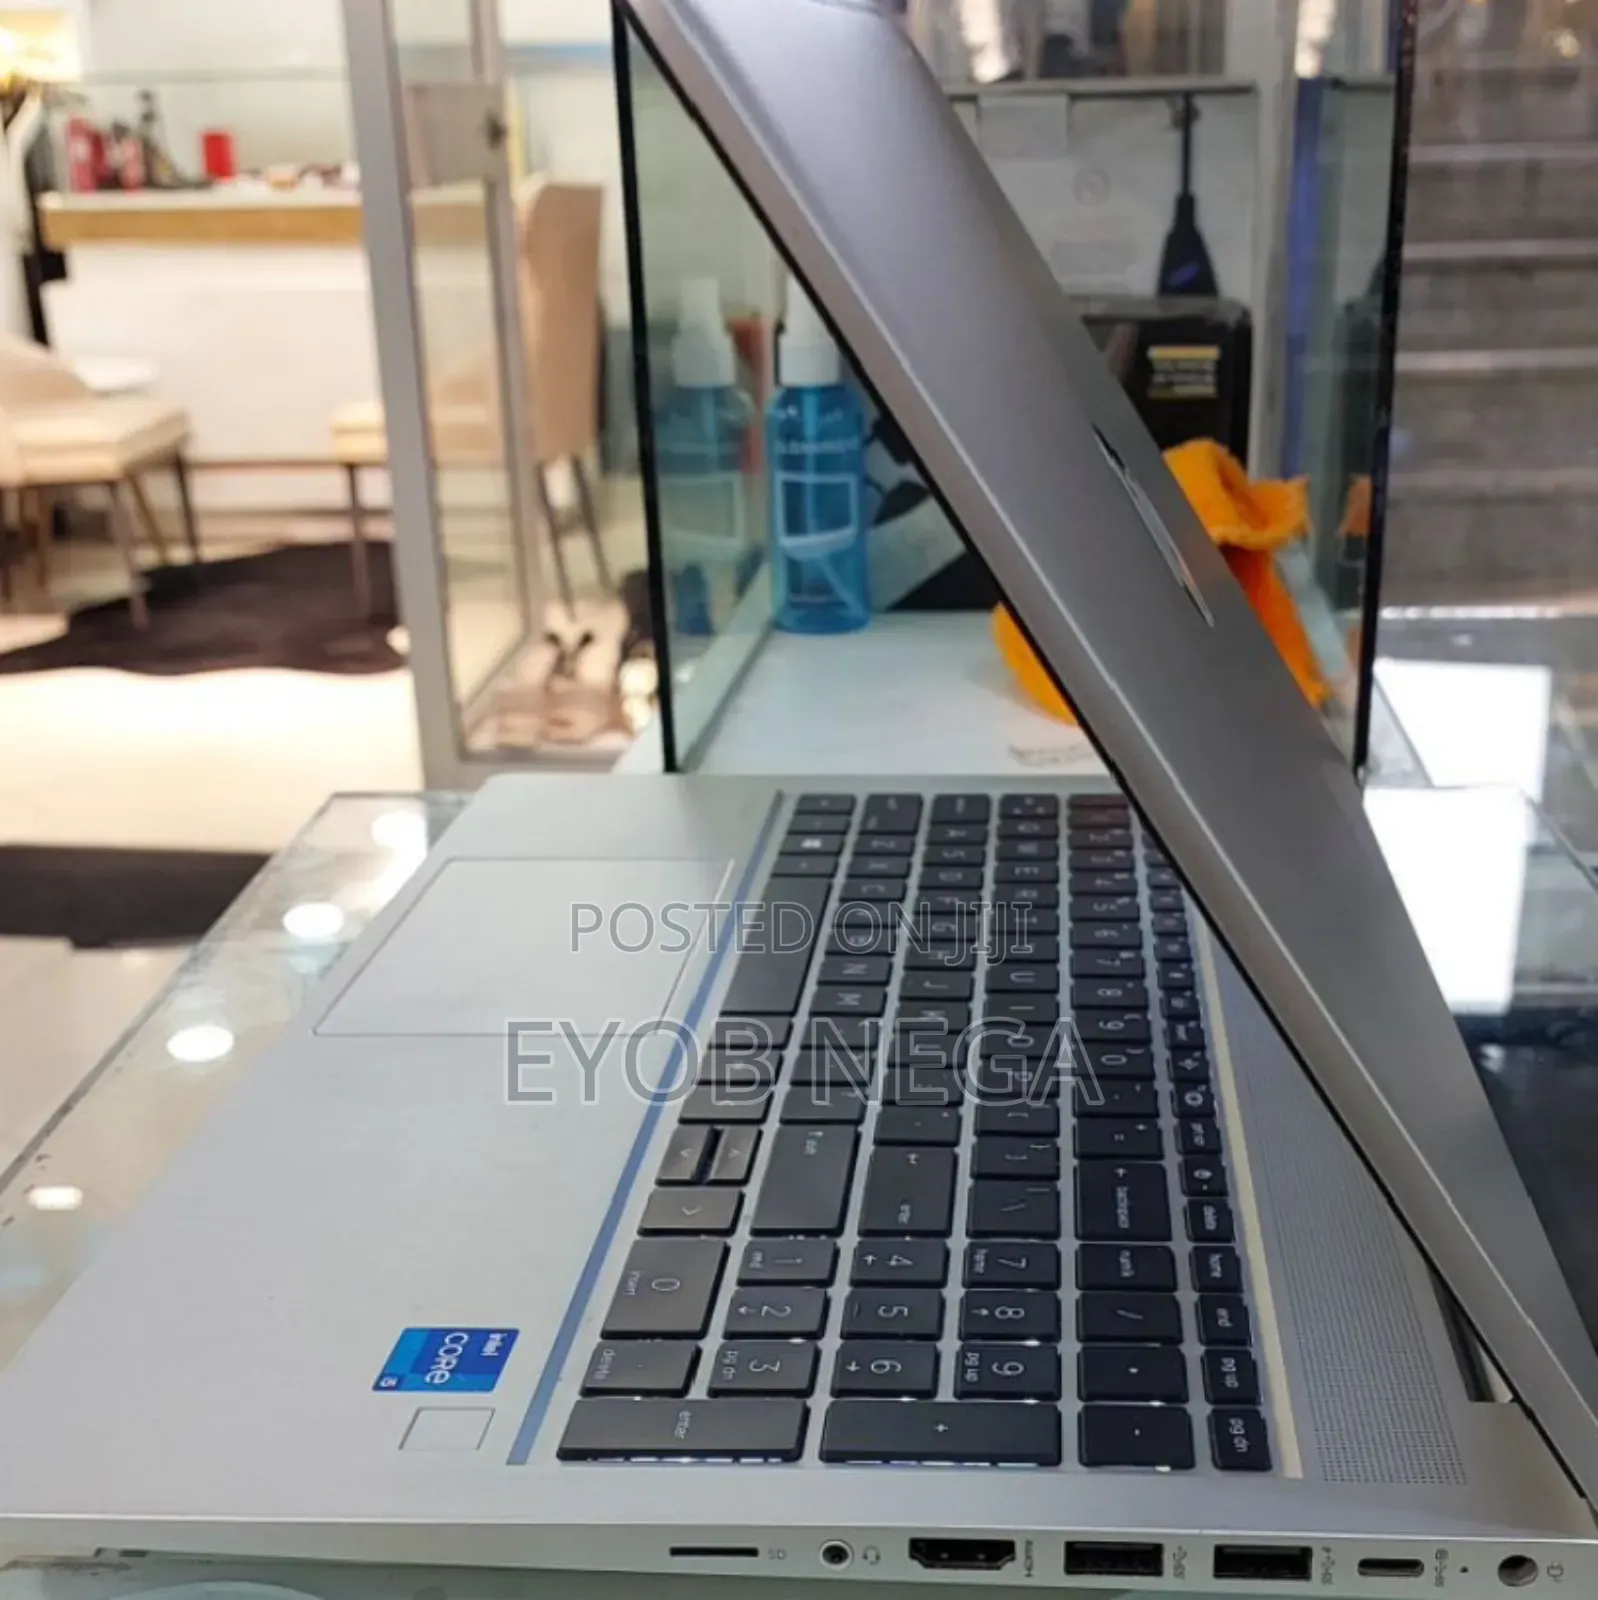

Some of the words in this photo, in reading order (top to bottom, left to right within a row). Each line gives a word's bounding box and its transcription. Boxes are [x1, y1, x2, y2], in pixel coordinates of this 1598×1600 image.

[841, 963, 868, 975] N
[1010, 972, 1036, 983] U
[1096, 988, 1123, 997] 8
[1098, 1020, 1125, 1031] 9
[1100, 1054, 1128, 1066] 0
[886, 1255, 914, 1267] 4
[997, 1257, 1027, 1270] 7
[651, 1277, 682, 1292] 0
[761, 1304, 793, 1318] 2
[877, 1305, 909, 1318] 5
[994, 1305, 1025, 1320] 8
[1216, 1307, 1232, 1328] end
[749, 1358, 781, 1373] 3
[870, 1359, 902, 1374] 6
[992, 1360, 1024, 1376] 9
[673, 1410, 693, 1441] enter
[1229, 1418, 1247, 1434] pg
[1233, 1436, 1250, 1453] dn
